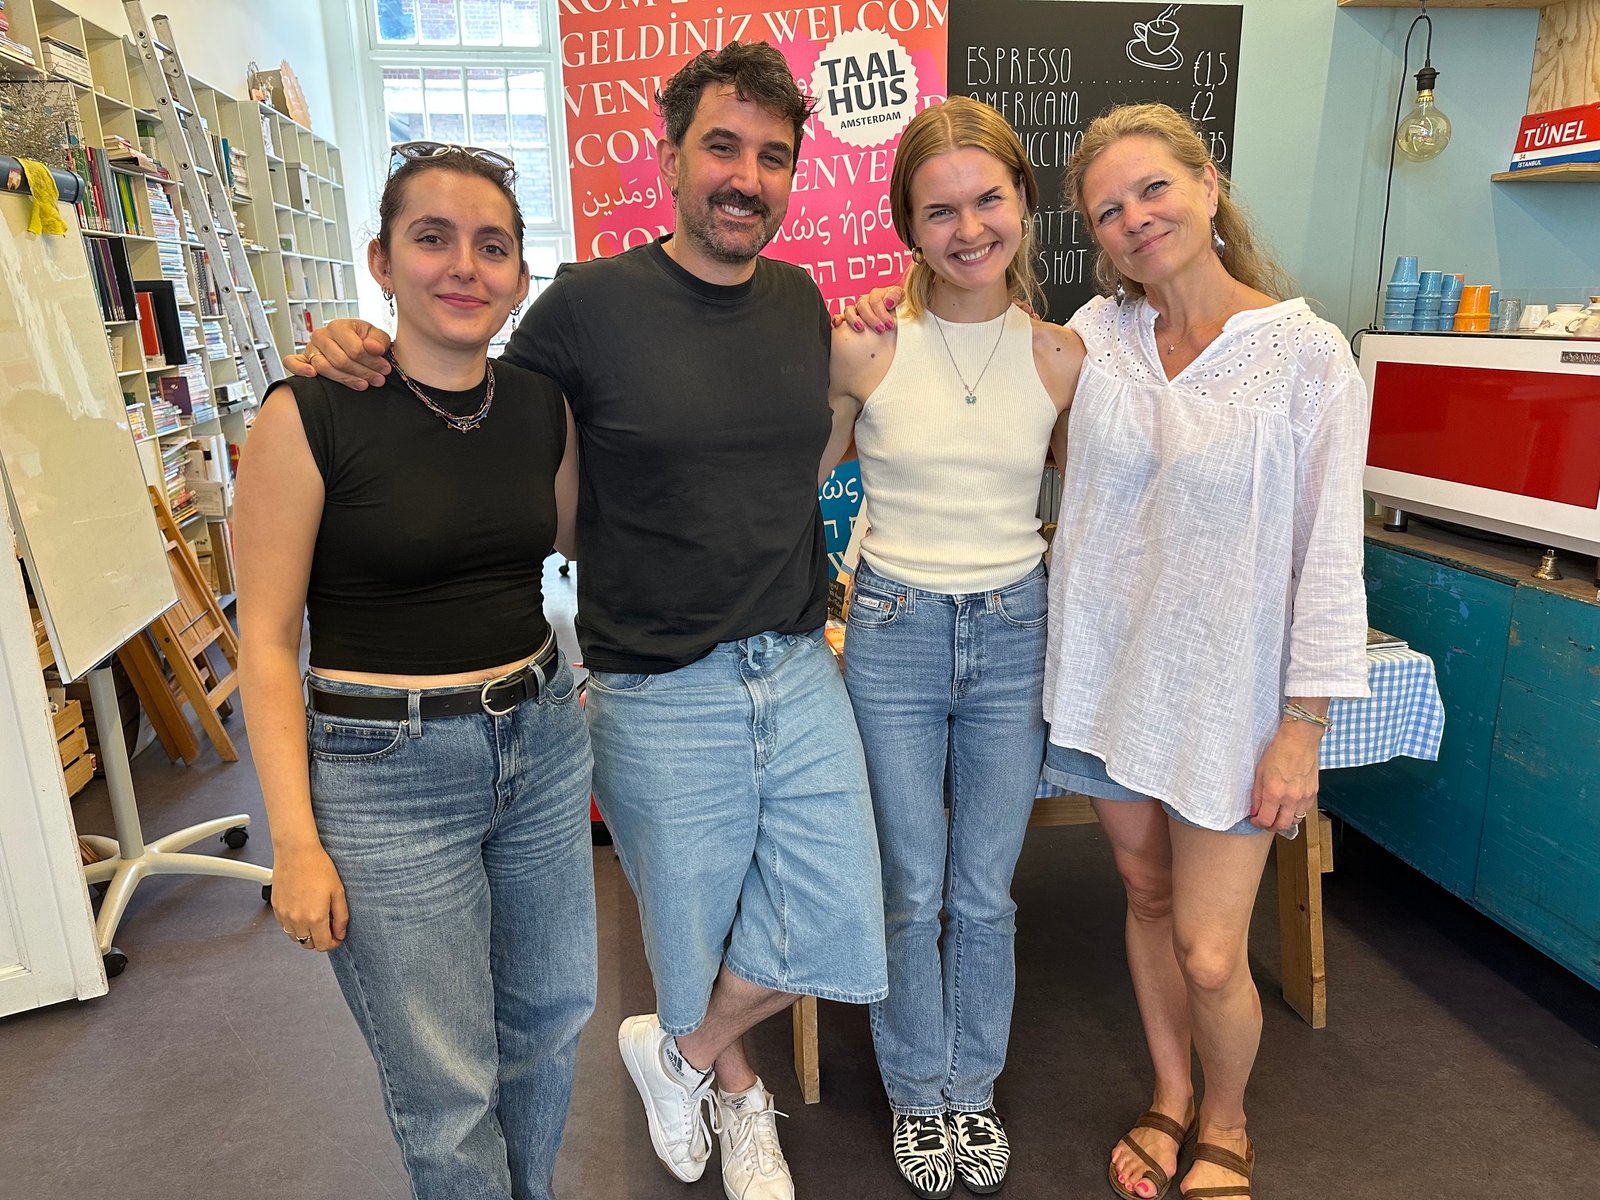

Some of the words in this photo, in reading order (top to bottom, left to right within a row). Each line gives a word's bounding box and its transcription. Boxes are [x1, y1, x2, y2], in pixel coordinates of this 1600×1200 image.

[820, 49, 906, 87] TAAL
[967, 46, 1072, 86] ESPRESSO
[1193, 50, 1228, 91] €1,5
[827, 77, 908, 116] HUIS
[1190, 91, 1216, 121] €2
[840, 111, 901, 130] AMSTERDAM
[1524, 120, 1587, 149] TÜNEL
[1038, 249, 1088, 285] SHOT
